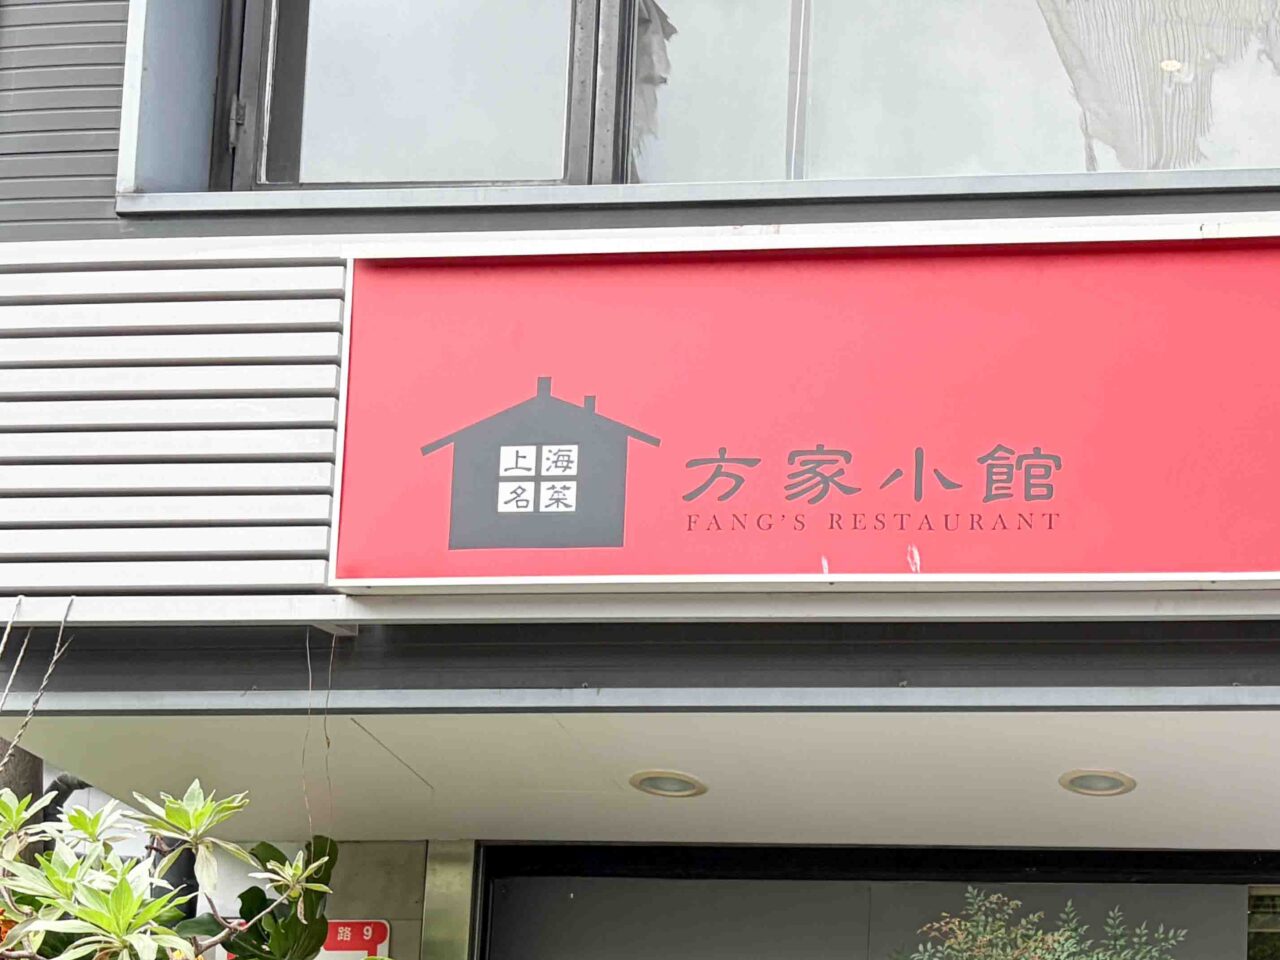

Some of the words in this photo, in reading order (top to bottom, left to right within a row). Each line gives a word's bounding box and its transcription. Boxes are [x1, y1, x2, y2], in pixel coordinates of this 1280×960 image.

[503, 448, 575, 473] 上海
[681, 443, 1063, 505] 方家小館
[503, 484, 574, 509] 名菜
[686, 512, 807, 532] FANG'S
[827, 512, 1061, 532] RESTAURANT
